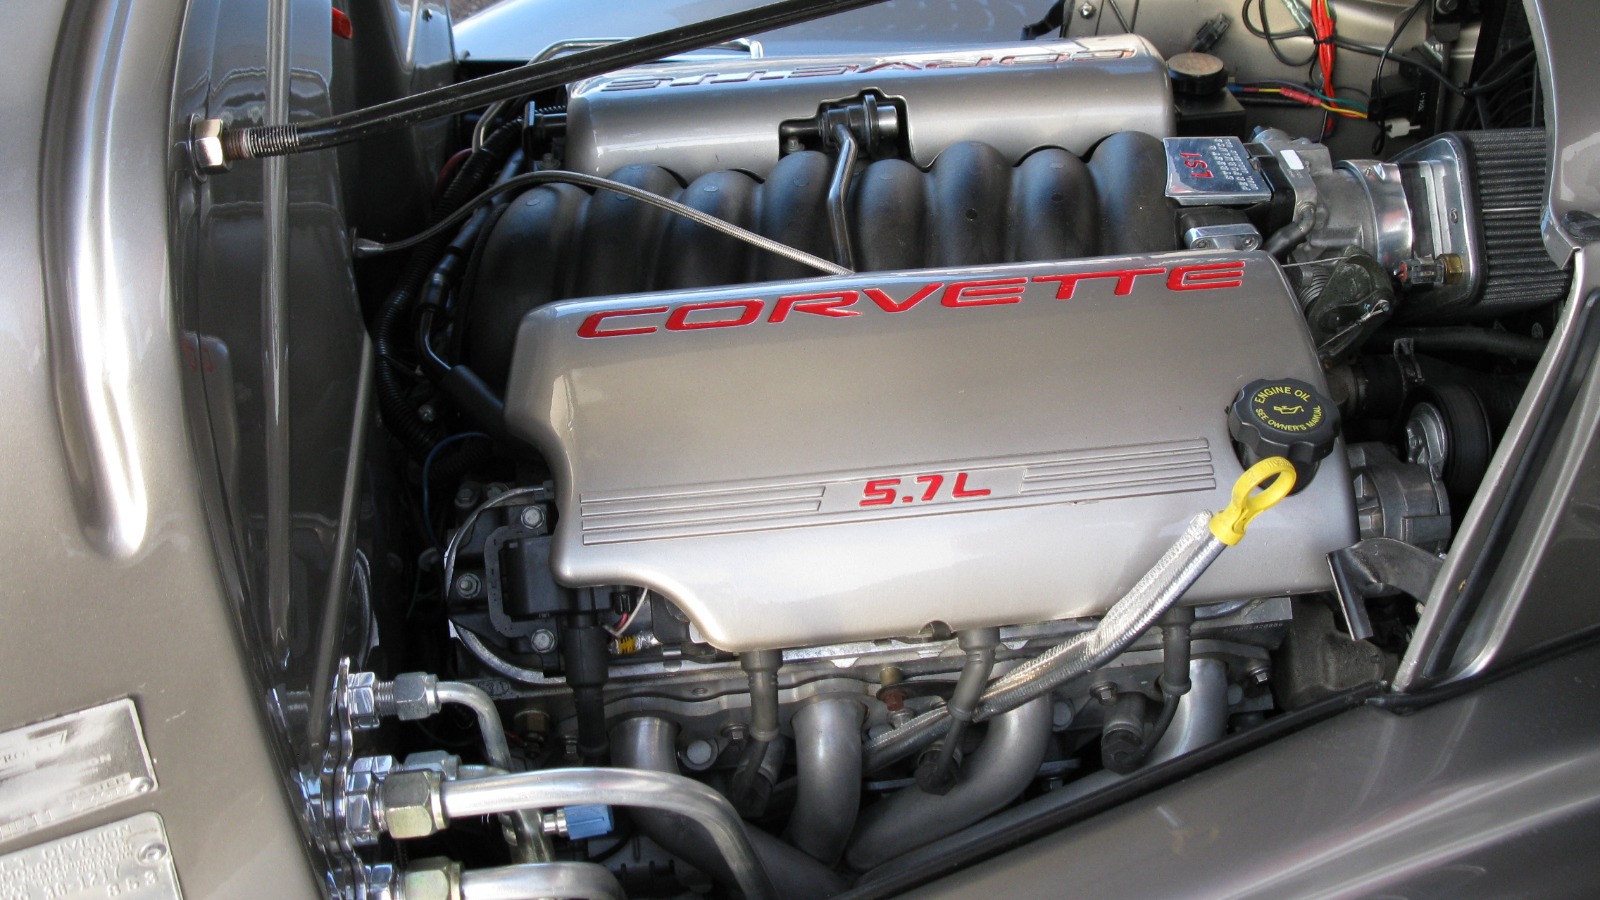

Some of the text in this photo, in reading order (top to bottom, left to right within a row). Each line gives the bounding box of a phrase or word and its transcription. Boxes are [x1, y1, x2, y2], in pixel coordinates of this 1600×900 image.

[1179, 152, 1214, 178] LS1
[577, 260, 1245, 339] CORVETTE
[1254, 386, 1311, 404] ENGINE OIL
[1255, 405, 1322, 432] SEE OWNER'S MANUAL
